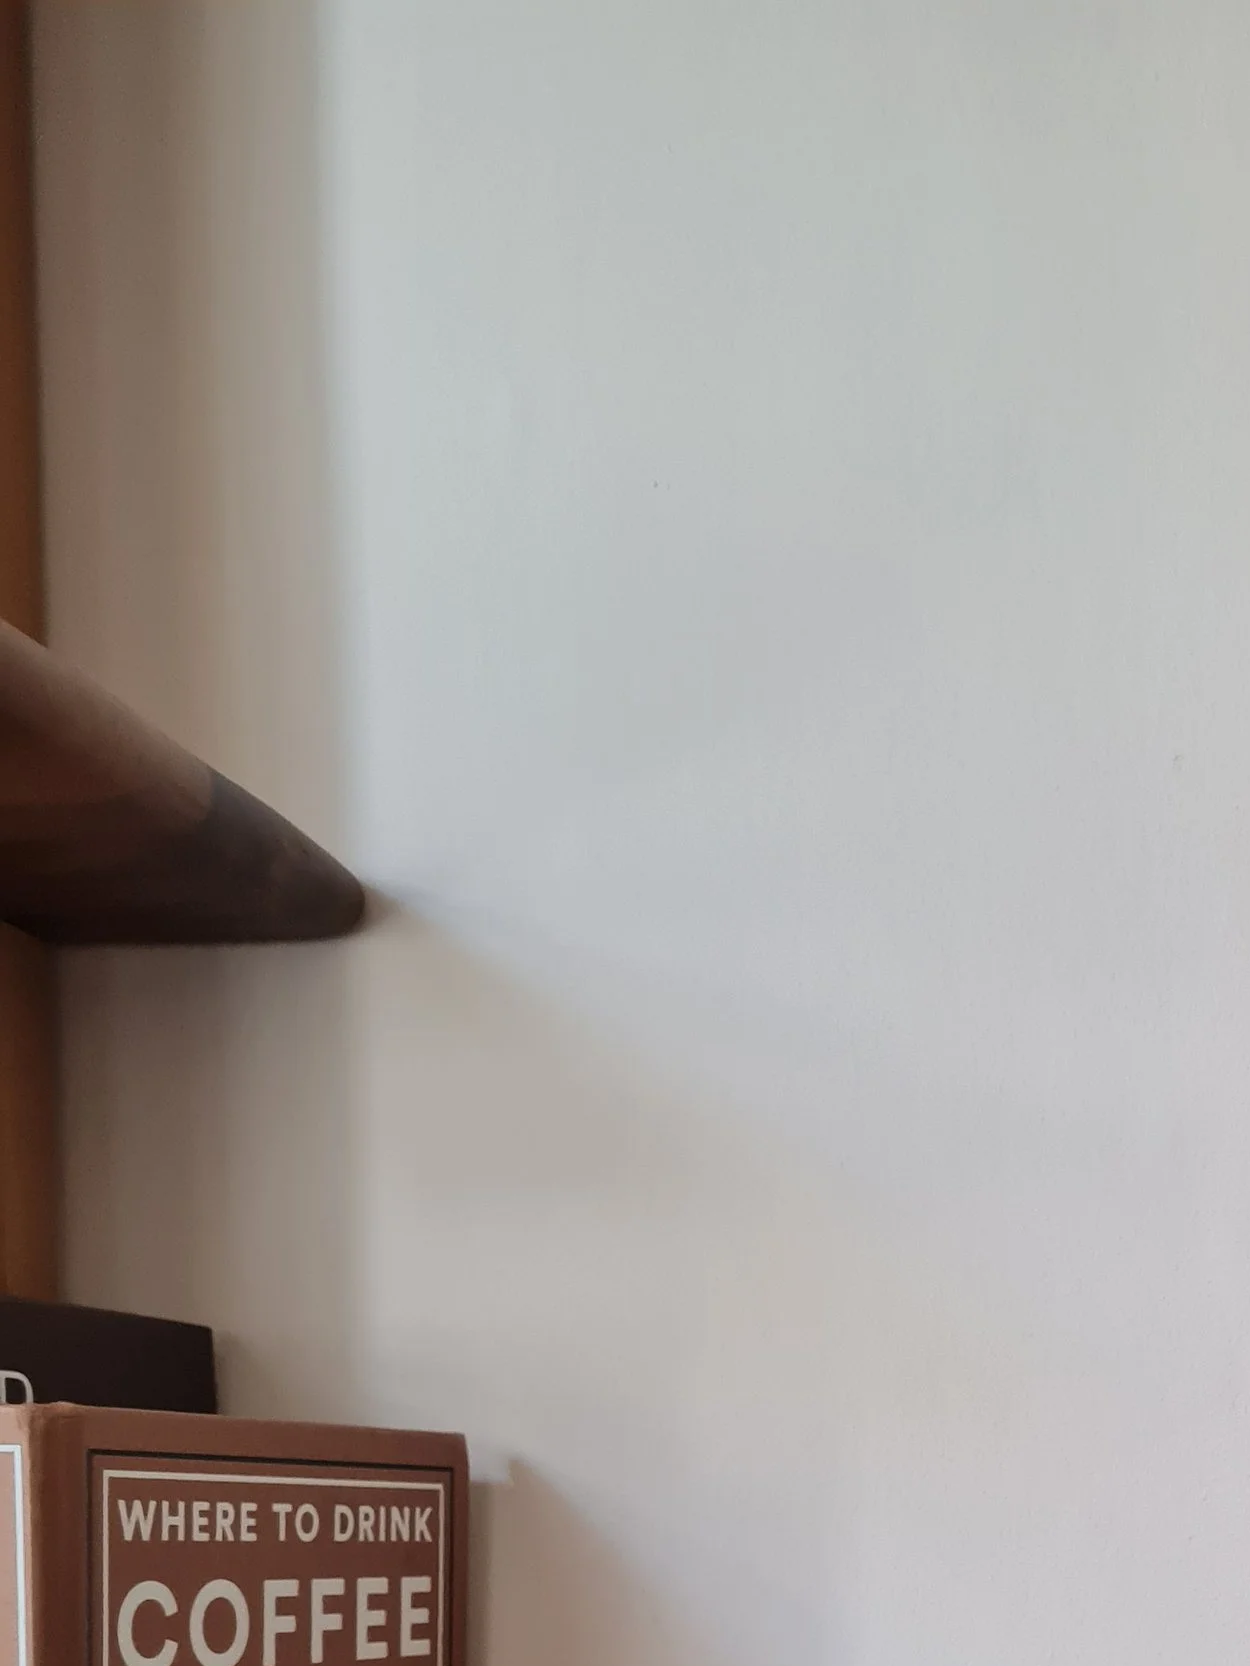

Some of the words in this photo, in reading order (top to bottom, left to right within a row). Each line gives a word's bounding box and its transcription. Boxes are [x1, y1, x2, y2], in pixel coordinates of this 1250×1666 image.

[117, 1499, 258, 1542] WHERE
[272, 1504, 321, 1542] TO
[333, 1506, 434, 1543] DRINK
